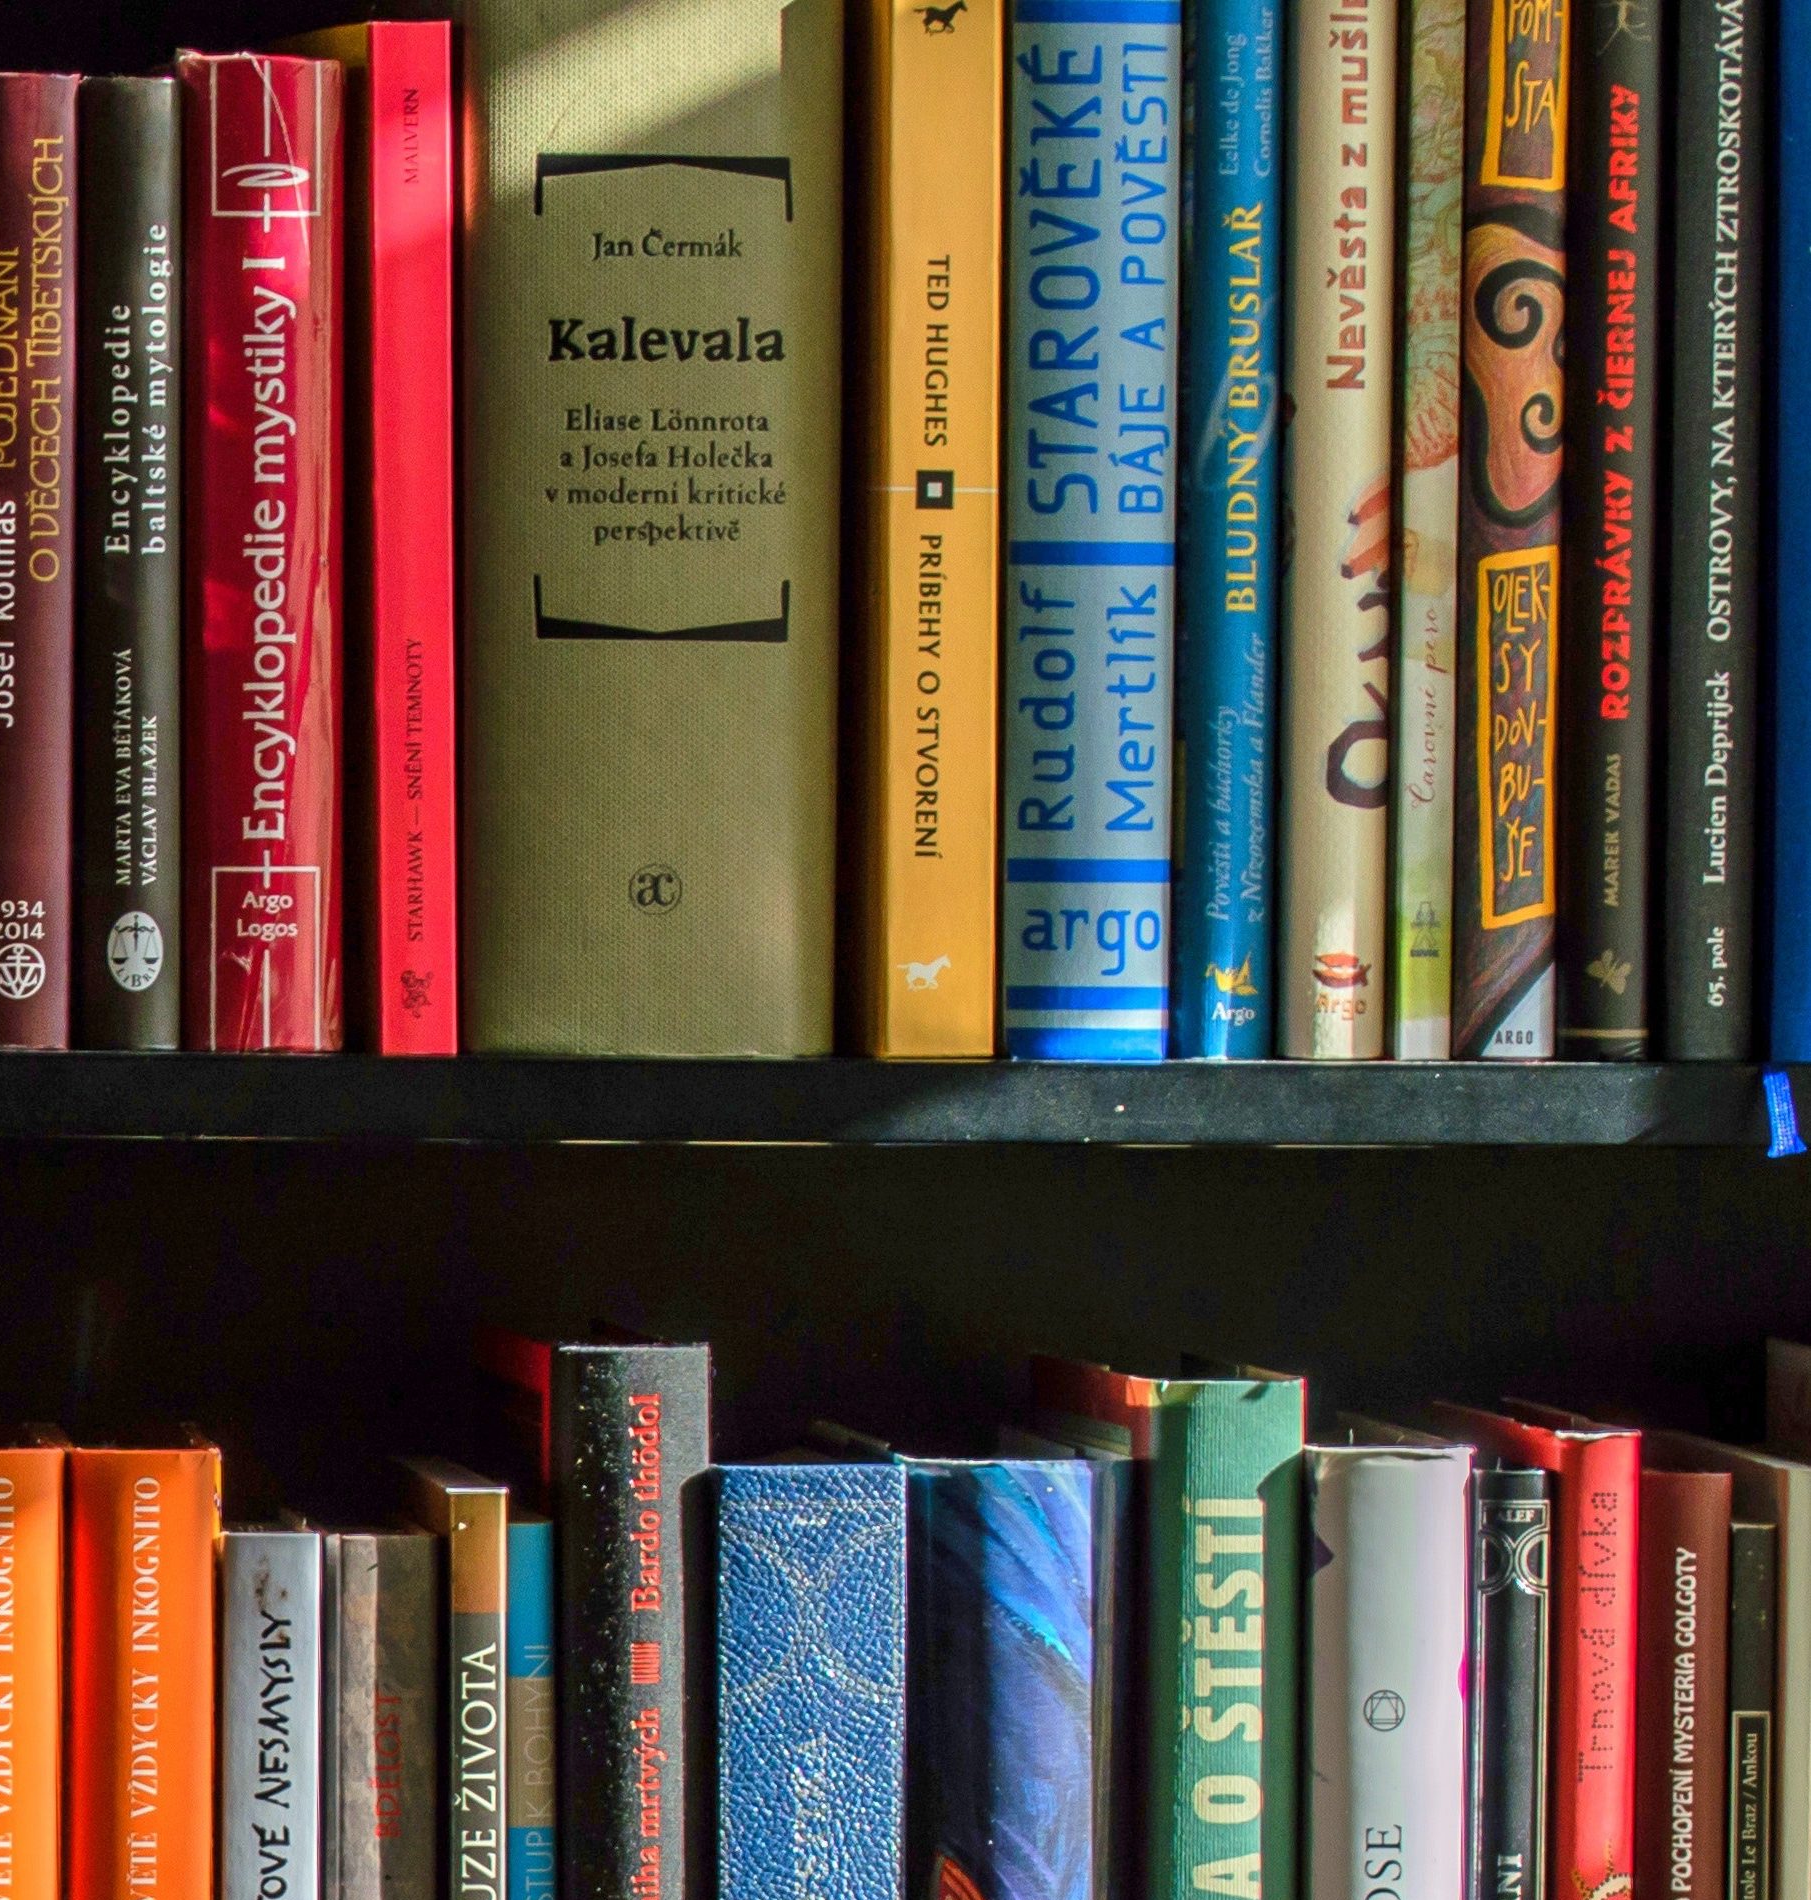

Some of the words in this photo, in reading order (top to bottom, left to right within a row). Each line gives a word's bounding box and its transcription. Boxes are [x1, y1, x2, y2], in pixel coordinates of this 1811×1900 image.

[402, 88, 420, 184] MALVERN
[1115, 42, 1169, 286] POVĚSTI
[590, 232, 636, 262] Jan
[641, 229, 744, 262] Čermák
[926, 255, 948, 310] TED
[1018, 43, 1103, 515] STAROVĚKÉ
[1220, 203, 1264, 411] BRUSLAŘ
[141, 224, 173, 407] mytologie
[548, 316, 786, 361] Kalevala
[1122, 318, 1167, 350] A
[103, 303, 136, 555] Encyklopedie
[242, 286, 296, 485] mystiky
[924, 322, 948, 446] HUGHES
[1111, 385, 1170, 515] BÁJE
[141, 421, 171, 555] baltské
[1216, 419, 1260, 614] BLUDNÝ
[244, 498, 296, 841] Encyklopedie
[1018, 580, 1078, 833] Rudolf
[1105, 583, 1157, 833] Mertlík
[1705, 671, 1734, 788] Deprijck
[406, 830, 424, 942] STARHAWK
[1704, 796, 1728, 884] Lucien
[1020, 908, 1160, 976] argo
[1182, 1494, 1263, 1744] ŠTĚSTÍ
[455, 1644, 501, 1812] ŽIVOTA
[1194, 1775, 1261, 1823] O
